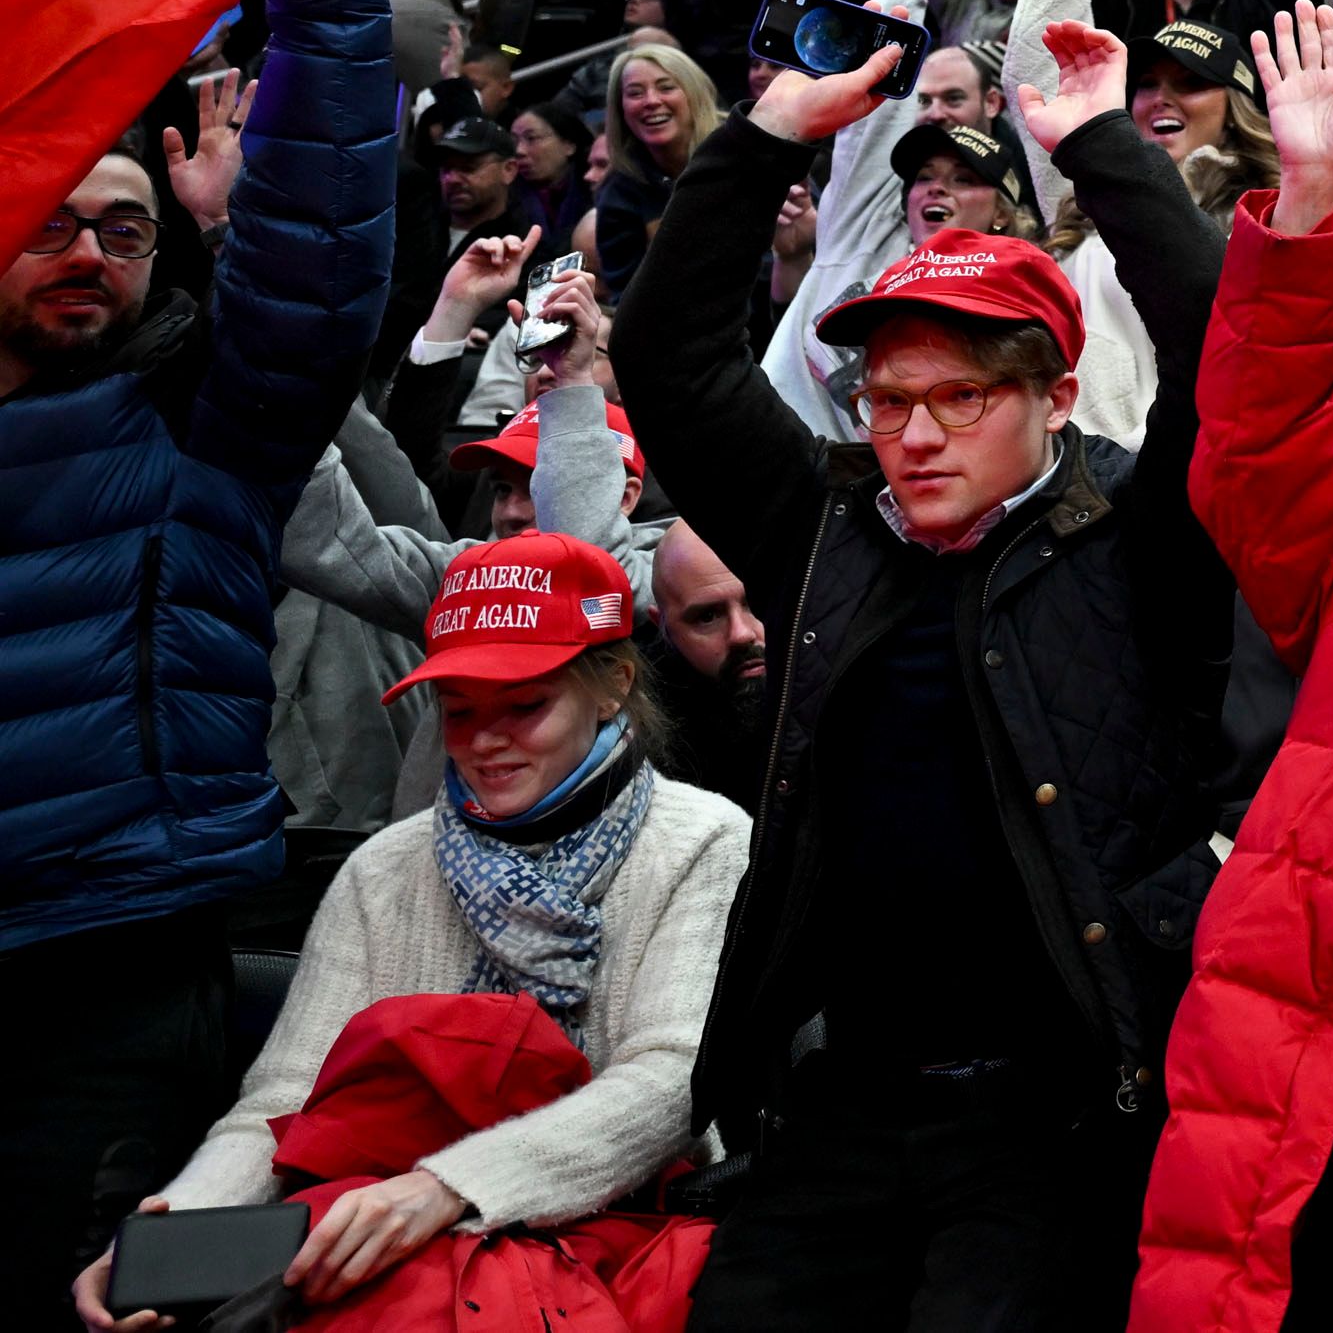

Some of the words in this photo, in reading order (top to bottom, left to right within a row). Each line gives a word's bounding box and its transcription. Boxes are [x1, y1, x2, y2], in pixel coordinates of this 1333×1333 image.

[1169, 20, 1225, 51] AMERICA
[1171, 35, 1213, 60] AGAIN
[951, 125, 1001, 154] AMERICA
[954, 135, 990, 158] AGAIN
[913, 249, 998, 265] AMERICA
[923, 265, 985, 279] AGAIN
[464, 565, 553, 595] AMERICA
[472, 603, 541, 631] AGAIN
